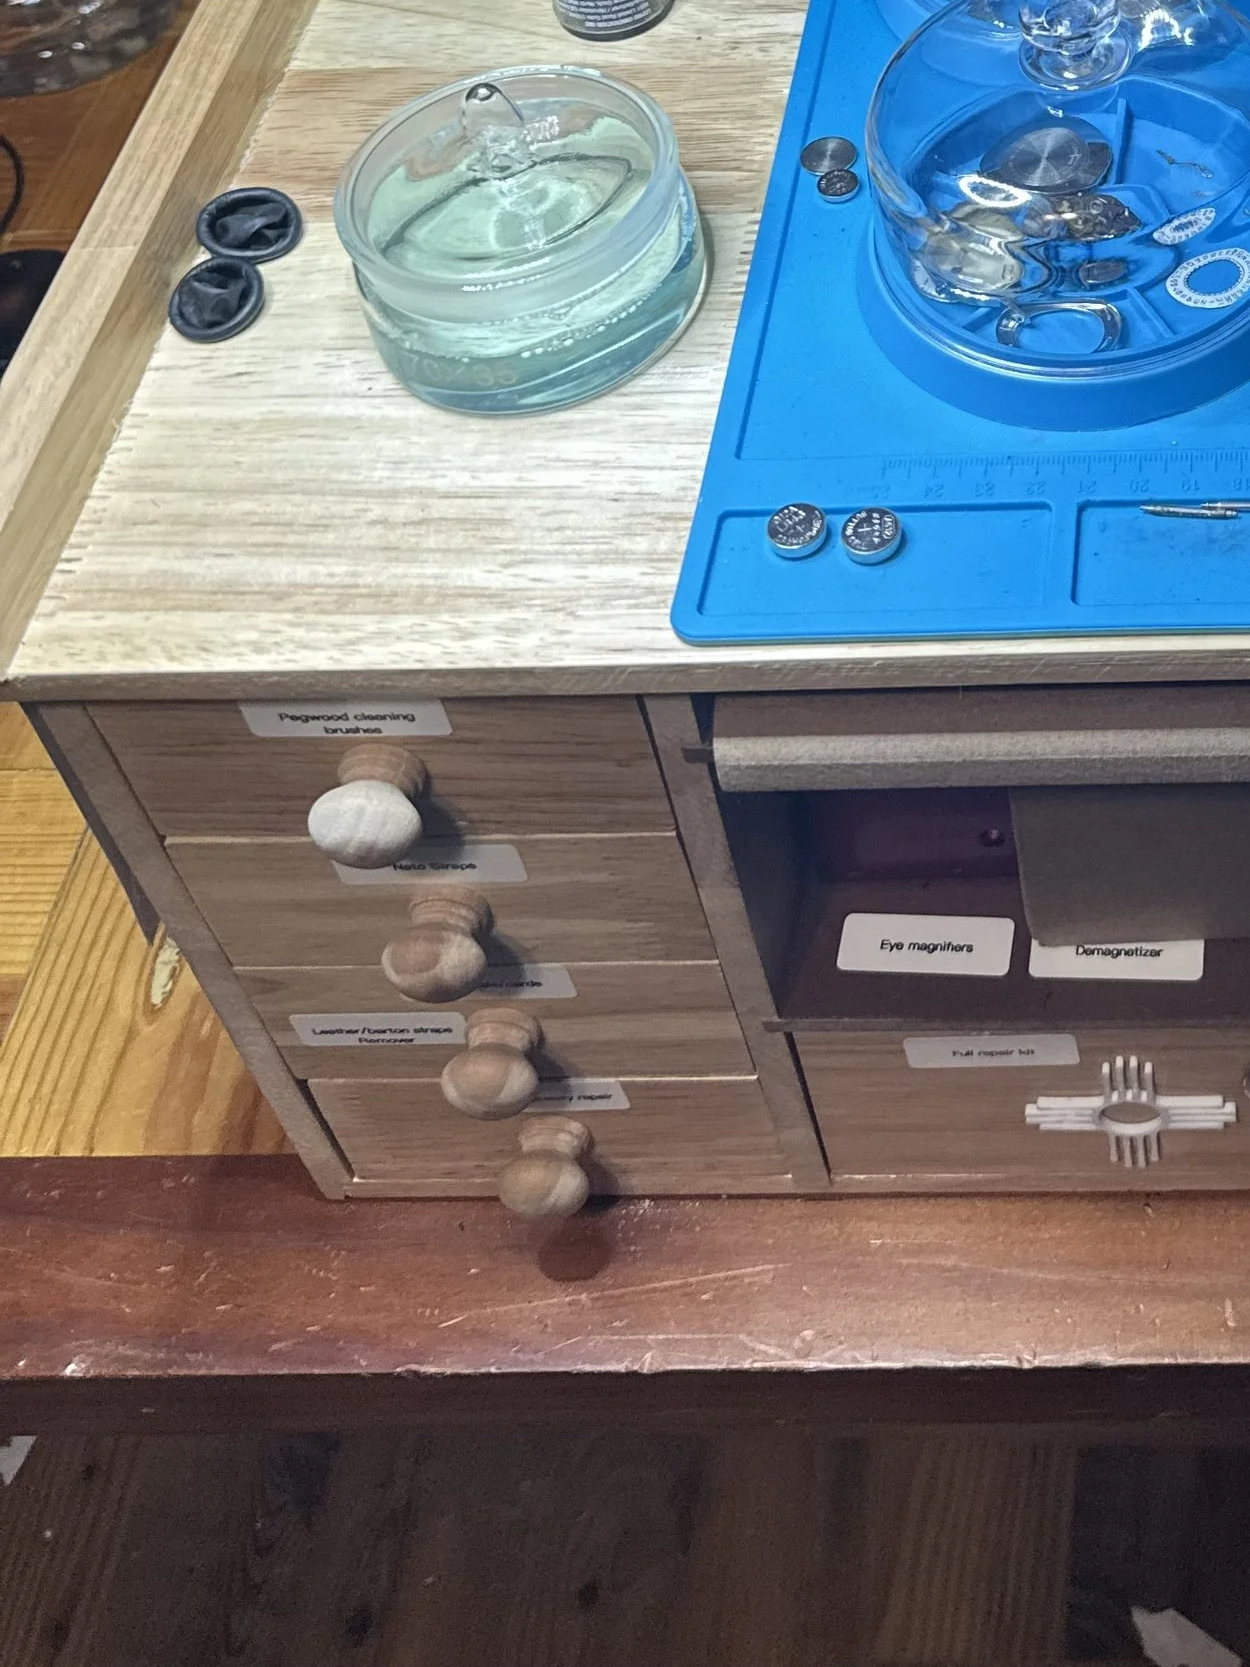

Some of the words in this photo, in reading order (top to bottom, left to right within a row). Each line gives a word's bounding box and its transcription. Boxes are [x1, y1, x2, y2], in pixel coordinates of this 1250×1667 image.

[278, 712, 349, 724] Pegwood
[353, 712, 416, 723] cleaning
[323, 726, 384, 735] brushes
[393, 862, 427, 872] Nato
[430, 861, 477, 873] Straps
[879, 938, 905, 953] Eye
[907, 940, 974, 955] magnifiers
[1074, 943, 1165, 960] Demagnetizer
[413, 1025, 453, 1036] straps
[951, 1048, 975, 1057] Full
